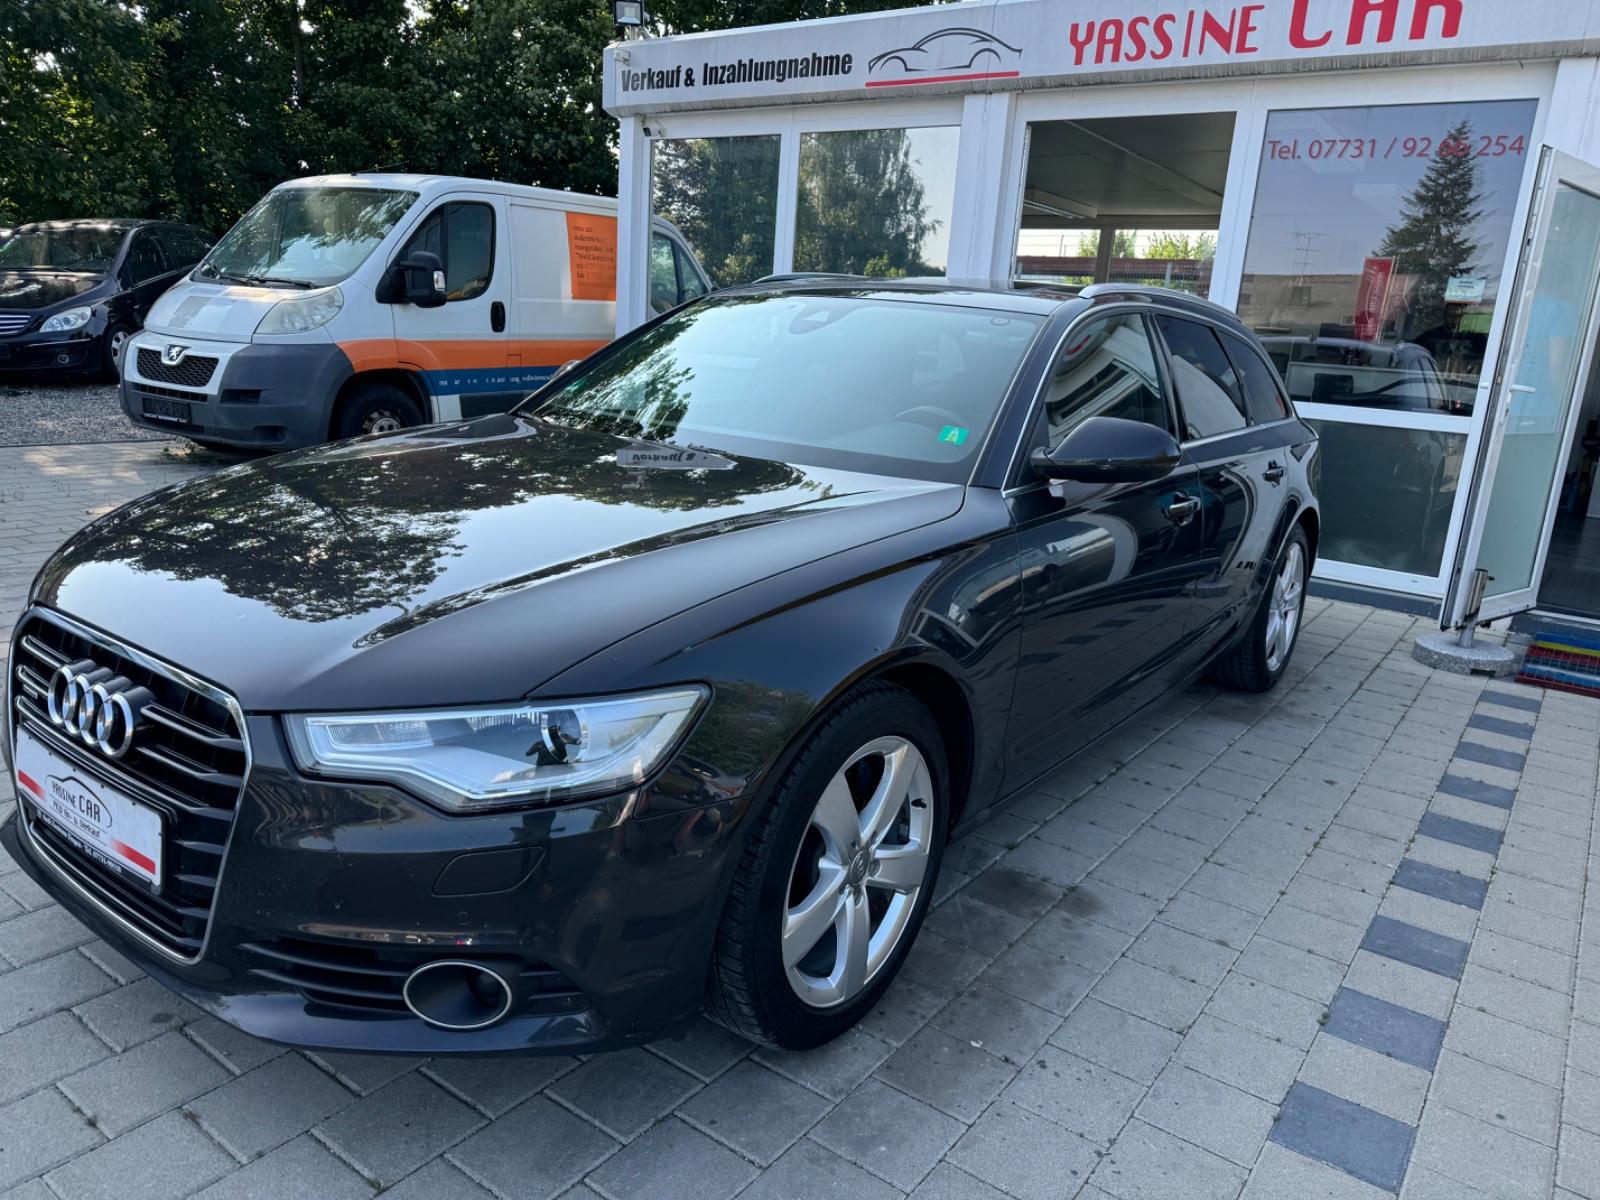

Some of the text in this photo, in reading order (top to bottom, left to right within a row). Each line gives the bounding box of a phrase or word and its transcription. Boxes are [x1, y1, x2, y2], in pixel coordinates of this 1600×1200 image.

[1069, 5, 1265, 65] YASSINE
[621, 52, 853, 92] Verkauf & Inzahlungnahme
[1267, 139, 1302, 161] Tel.
[1308, 138, 1376, 159] 07731
[1383, 136, 1398, 160] /
[1402, 136, 1431, 158] 92
[1475, 134, 1525, 157] 254
[52, 781, 100, 822] YASSINE CAR
